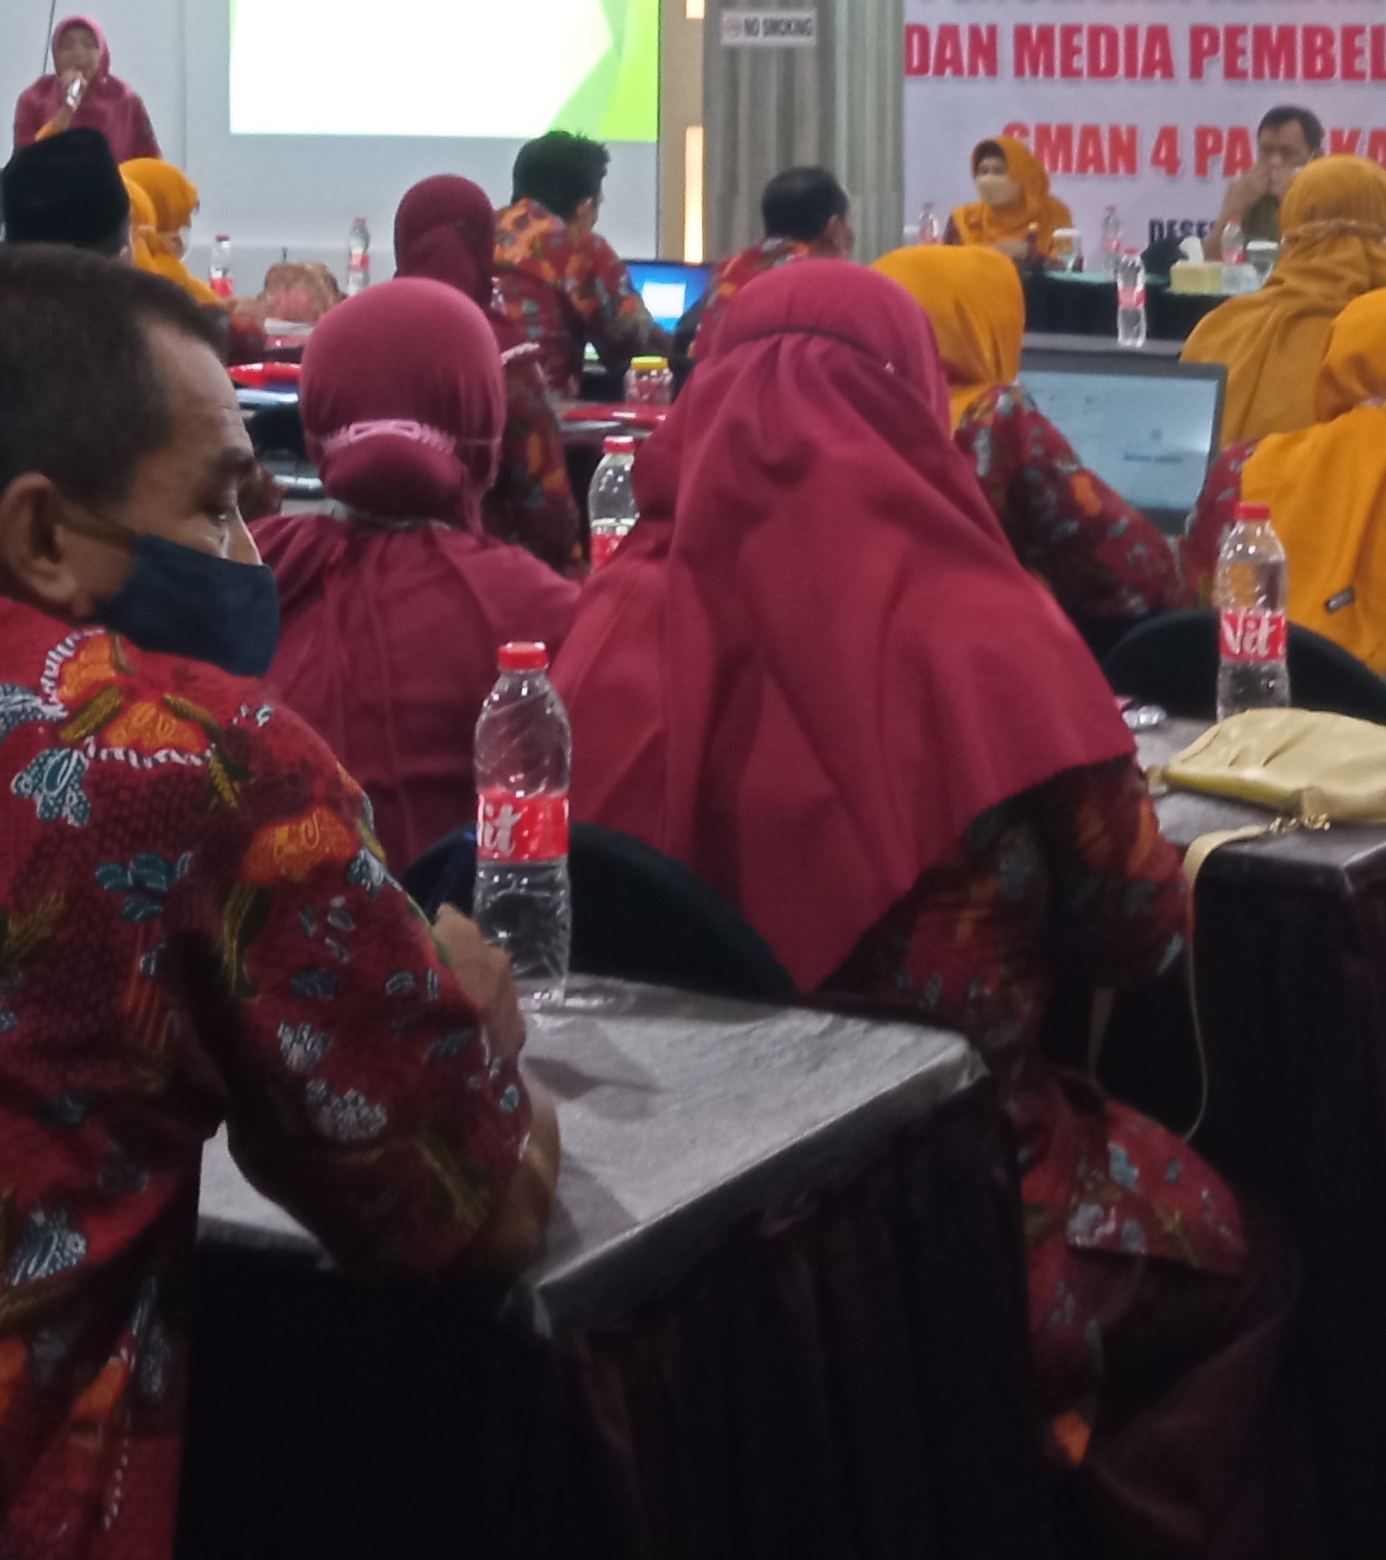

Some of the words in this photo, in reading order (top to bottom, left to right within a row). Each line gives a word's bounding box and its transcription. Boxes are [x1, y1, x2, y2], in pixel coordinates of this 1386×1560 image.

[744, 18, 760, 37] NO
[904, 23, 999, 78] DAN
[1013, 23, 1175, 80] MEDIA
[1152, 125, 1181, 178] 4
[1221, 608, 1277, 656] Vit
[476, 793, 528, 857] it
